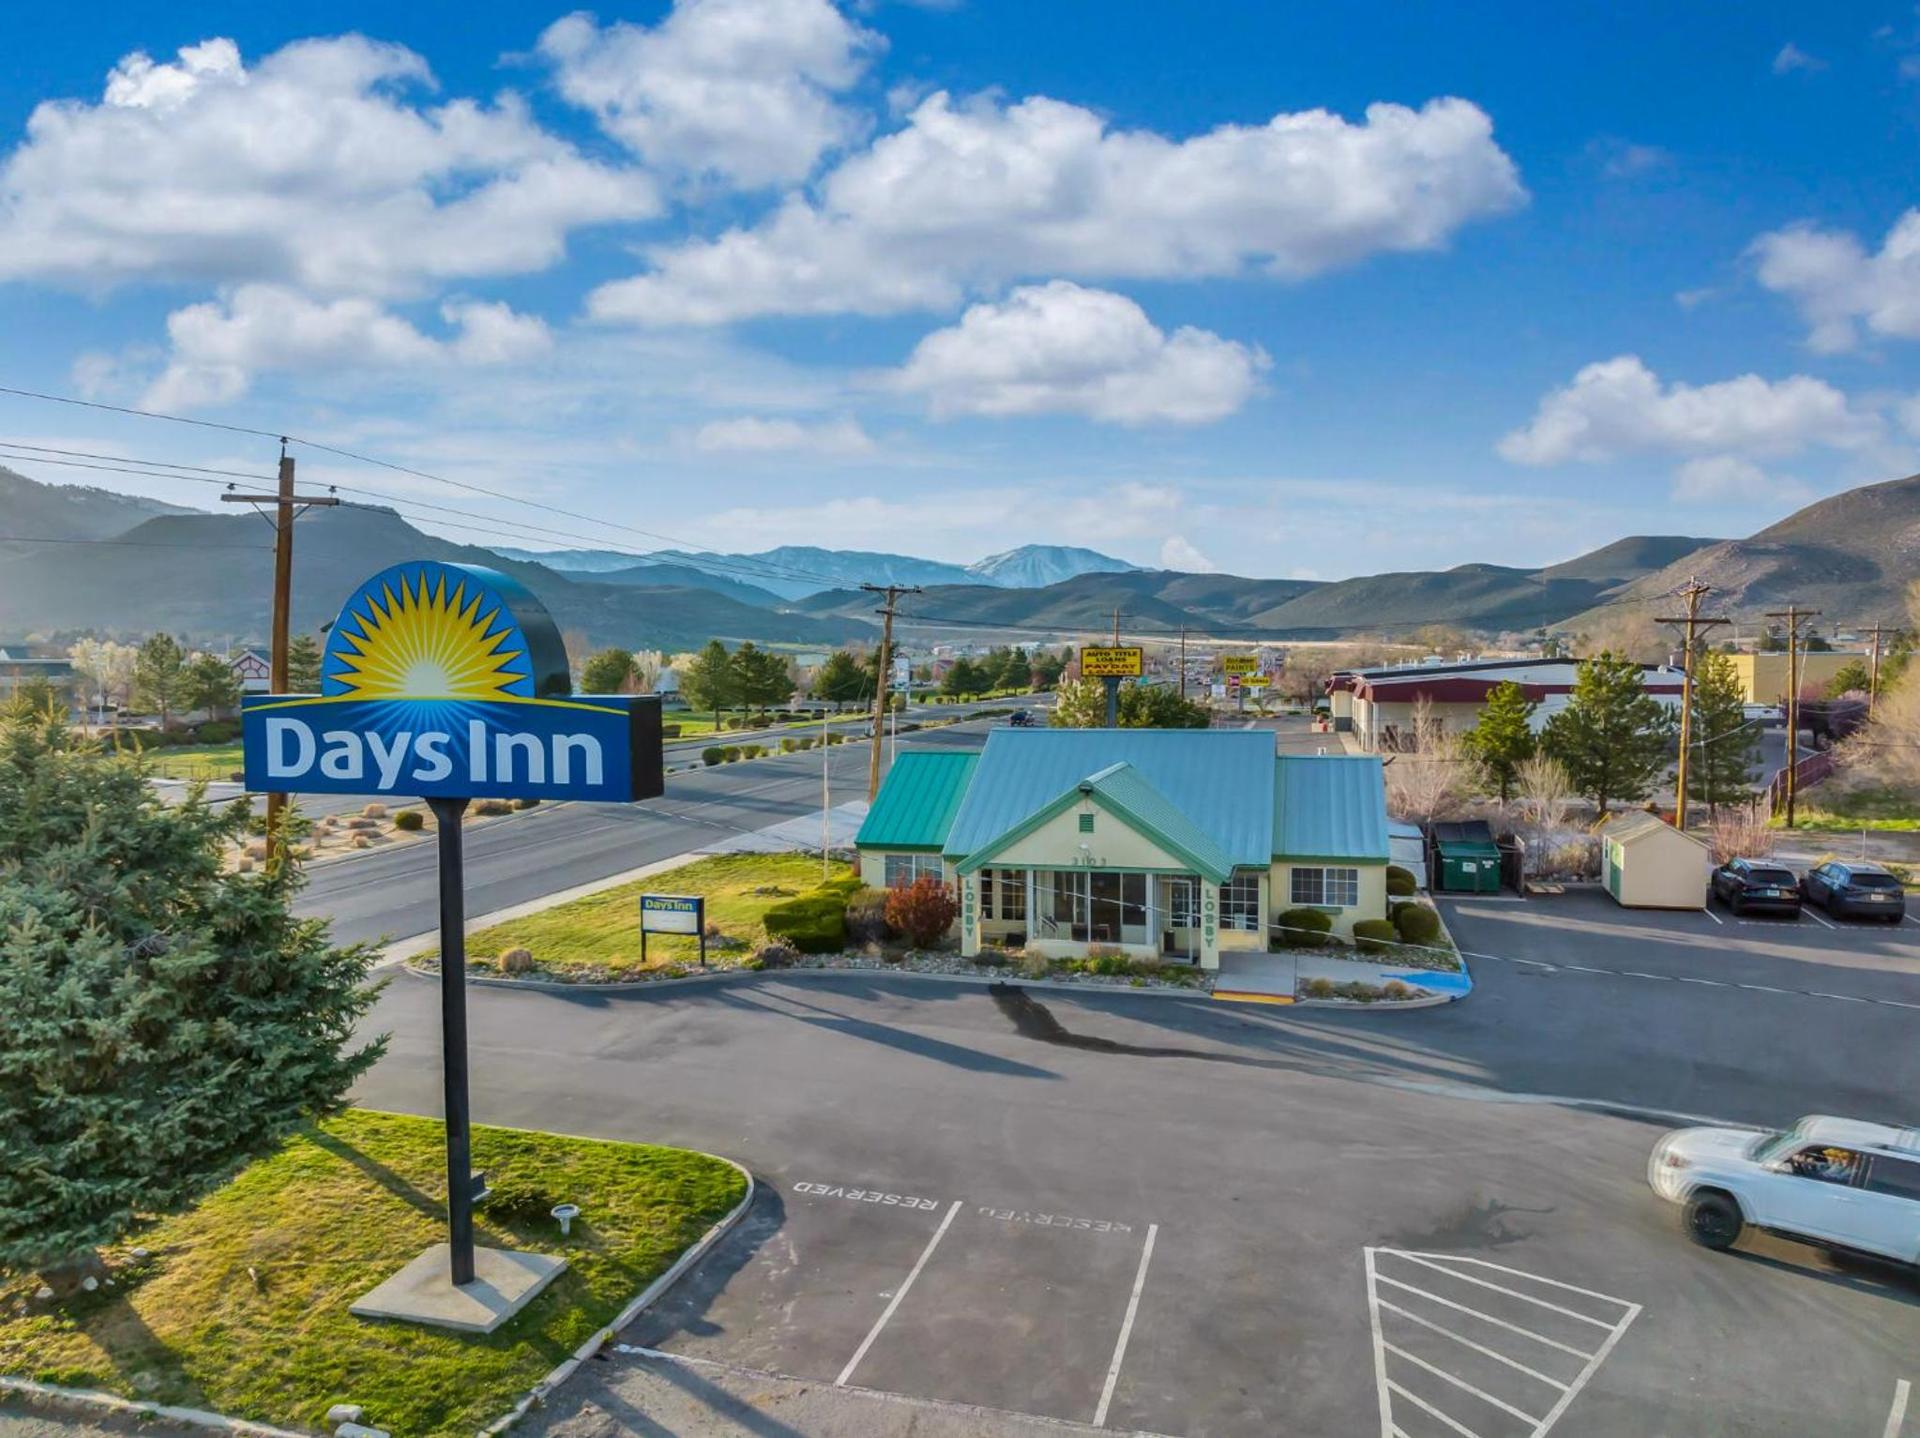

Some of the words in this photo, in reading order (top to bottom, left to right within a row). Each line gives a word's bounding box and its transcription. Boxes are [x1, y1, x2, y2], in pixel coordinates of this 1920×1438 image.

[265, 716, 454, 790] Days
[468, 719, 605, 786] Inn
[645, 899, 672, 910] Days
[674, 901, 693, 911] Inn
[965, 879, 975, 937] LOBBY
[1204, 888, 1215, 948] LOBBY
[793, 1181, 939, 1211] RESERVED
